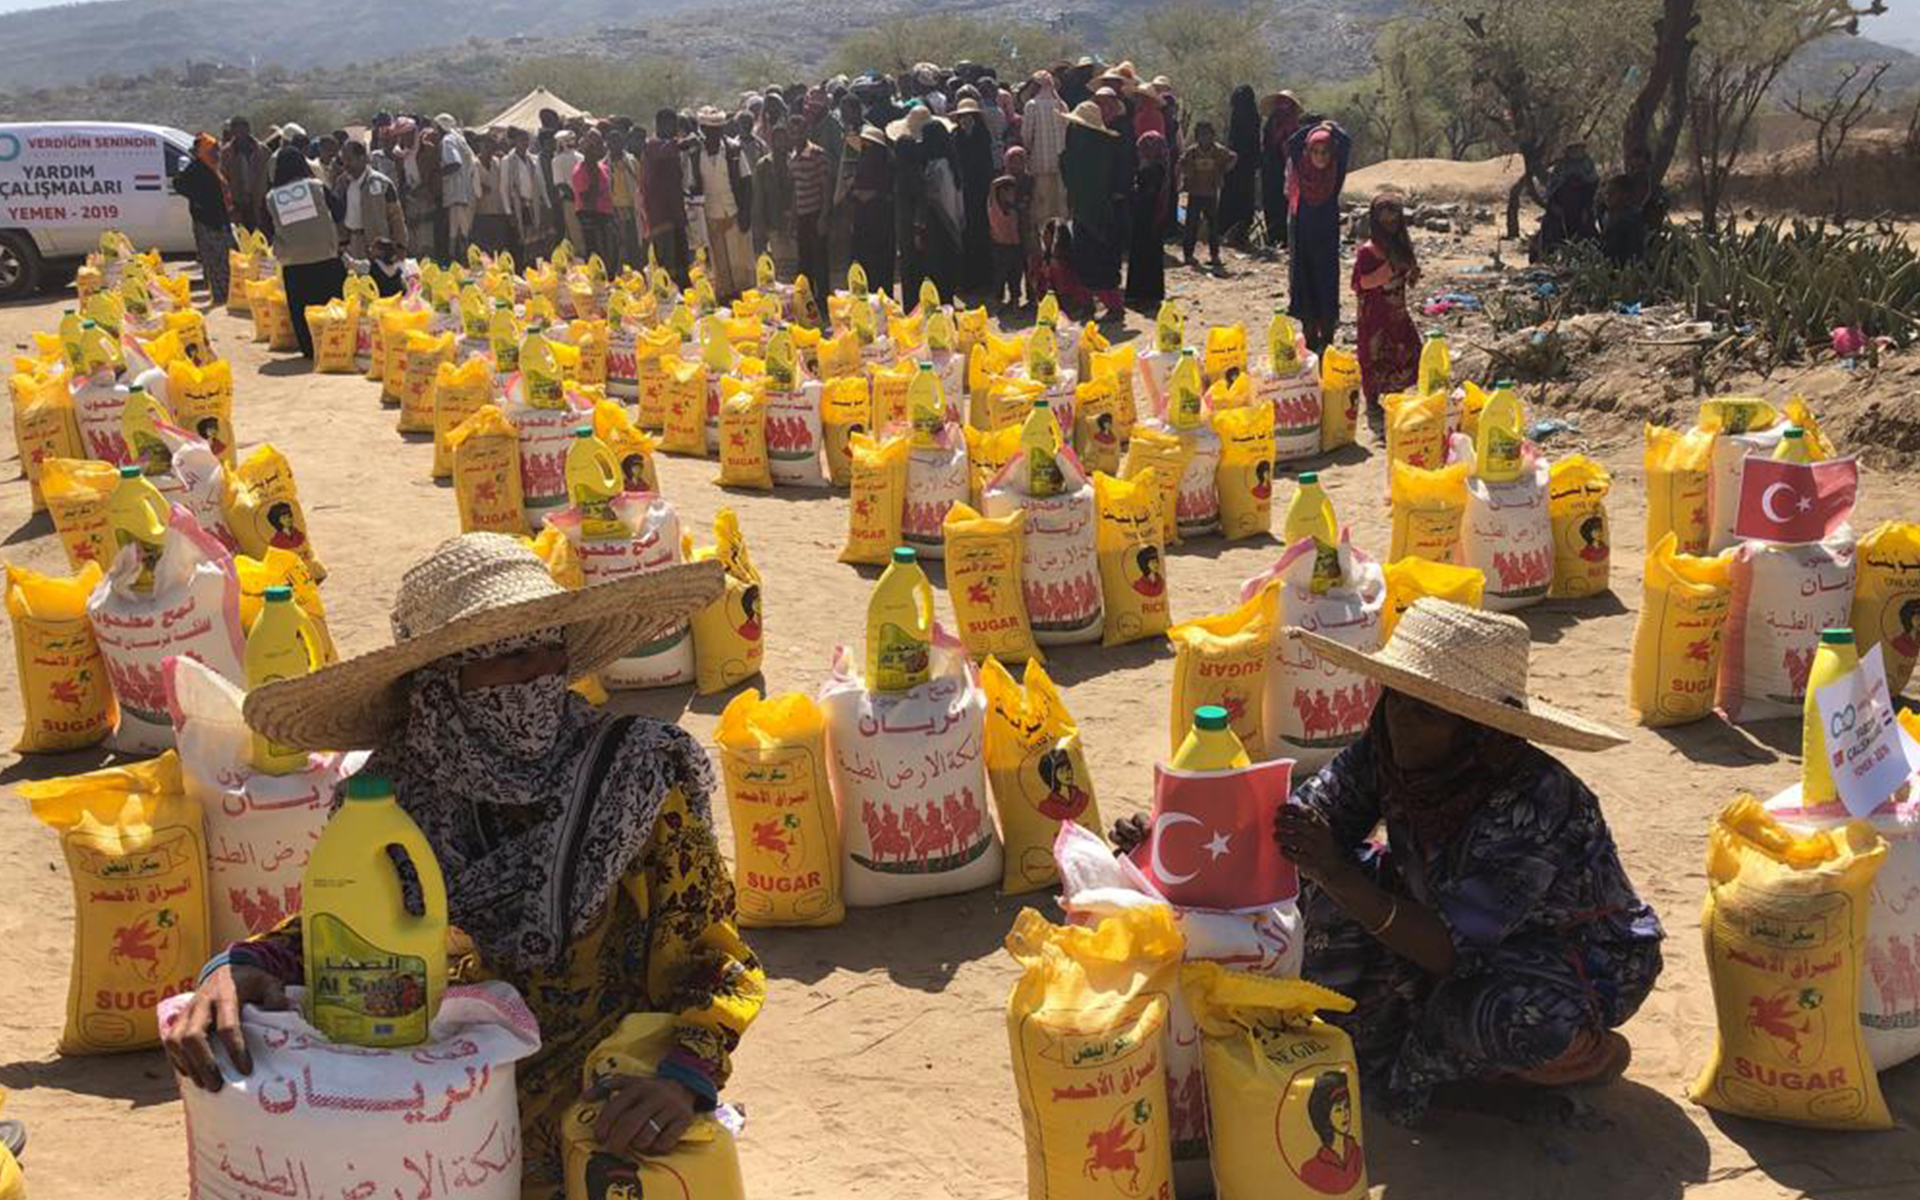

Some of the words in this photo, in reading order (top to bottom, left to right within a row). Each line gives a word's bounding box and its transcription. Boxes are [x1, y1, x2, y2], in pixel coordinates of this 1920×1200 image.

[23, 164, 95, 180] YARDIM
[0, 180, 122, 200] ÇALIŞMALARI
[8, 206, 66, 220] YEMEN
[81, 204, 119, 219] 2019
[968, 616, 1021, 634] SUGAR
[1199, 658, 1264, 678] SUGAR
[747, 871, 821, 892] SUGAR
[96, 977, 196, 1011] SUGAR
[1734, 1056, 1848, 1090] SUGAR
